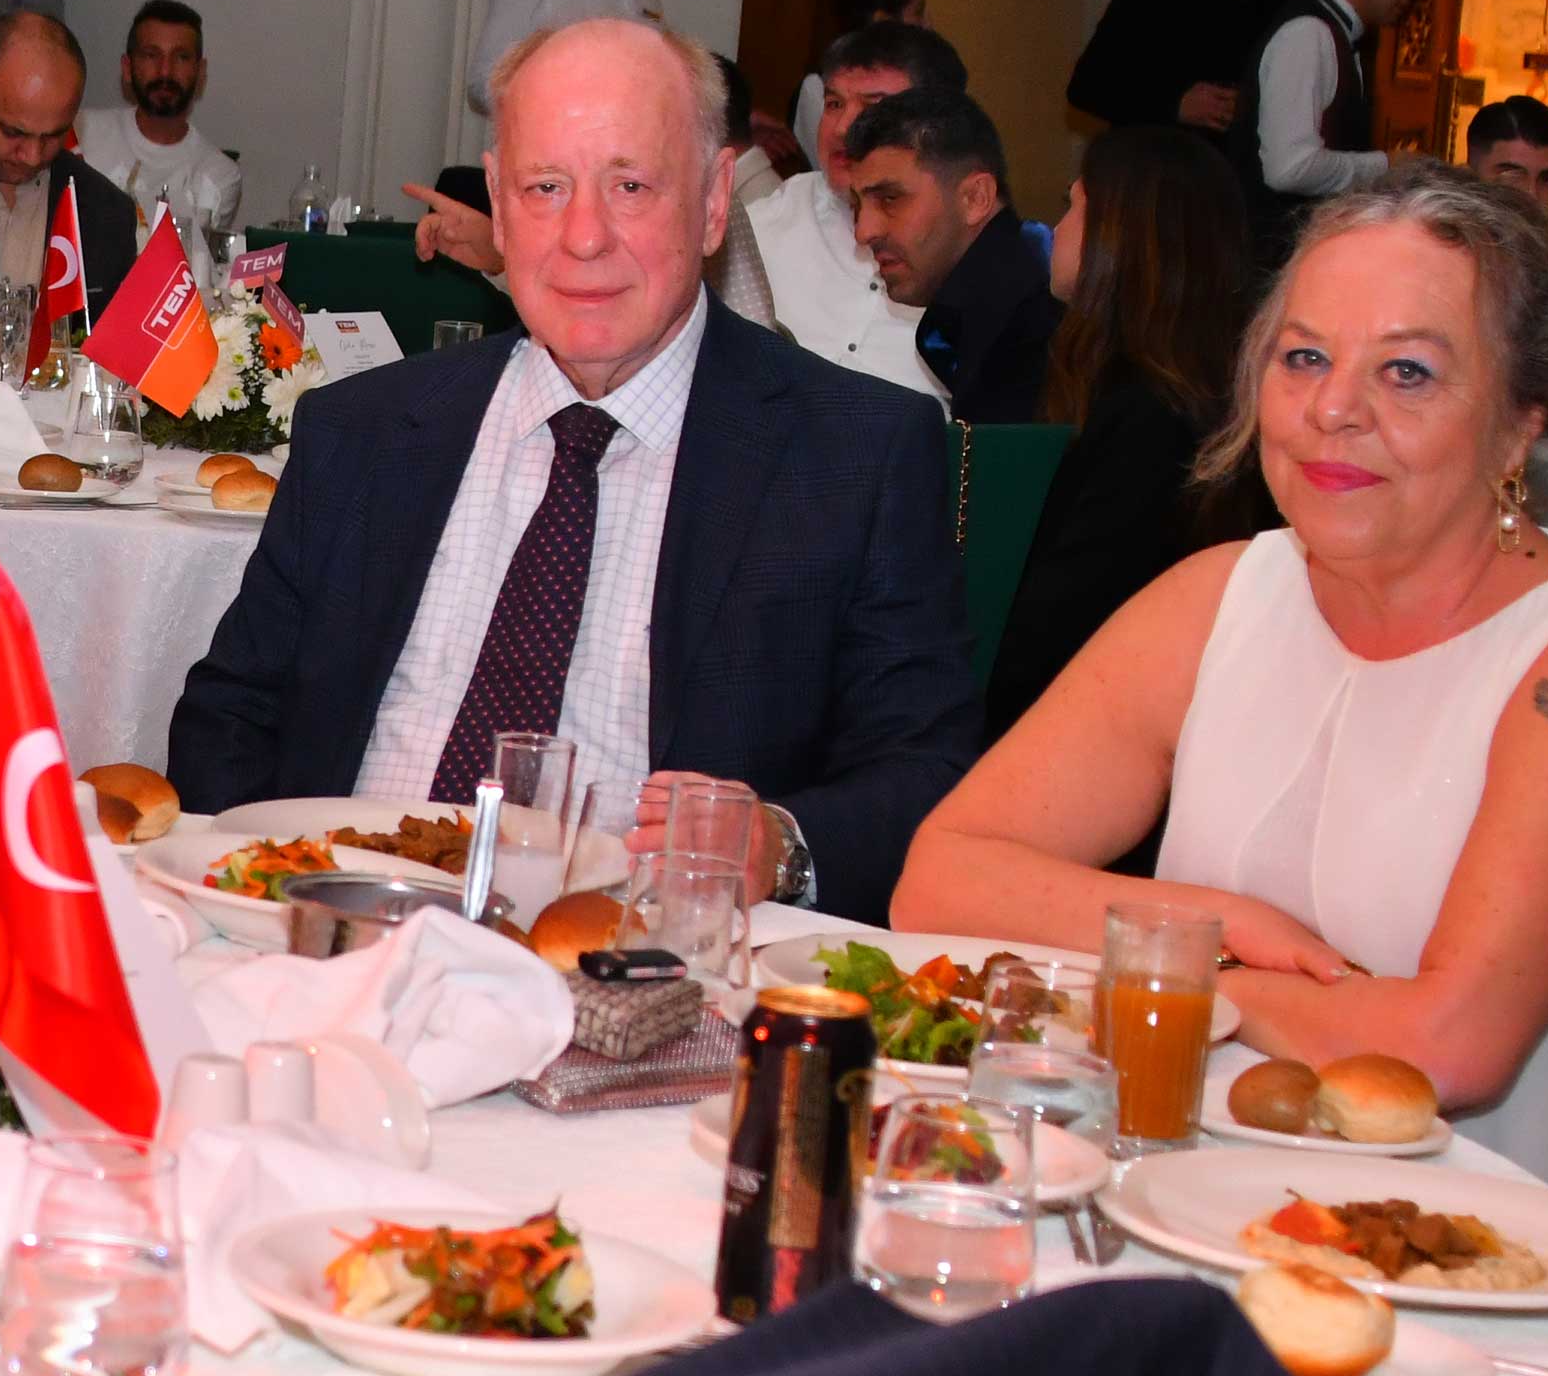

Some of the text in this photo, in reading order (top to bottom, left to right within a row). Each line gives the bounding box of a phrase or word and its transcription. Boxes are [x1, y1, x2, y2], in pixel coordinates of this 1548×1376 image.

[241, 252, 283, 273] TEM
[150, 270, 193, 328] TEM
[268, 285, 302, 332] TEM
